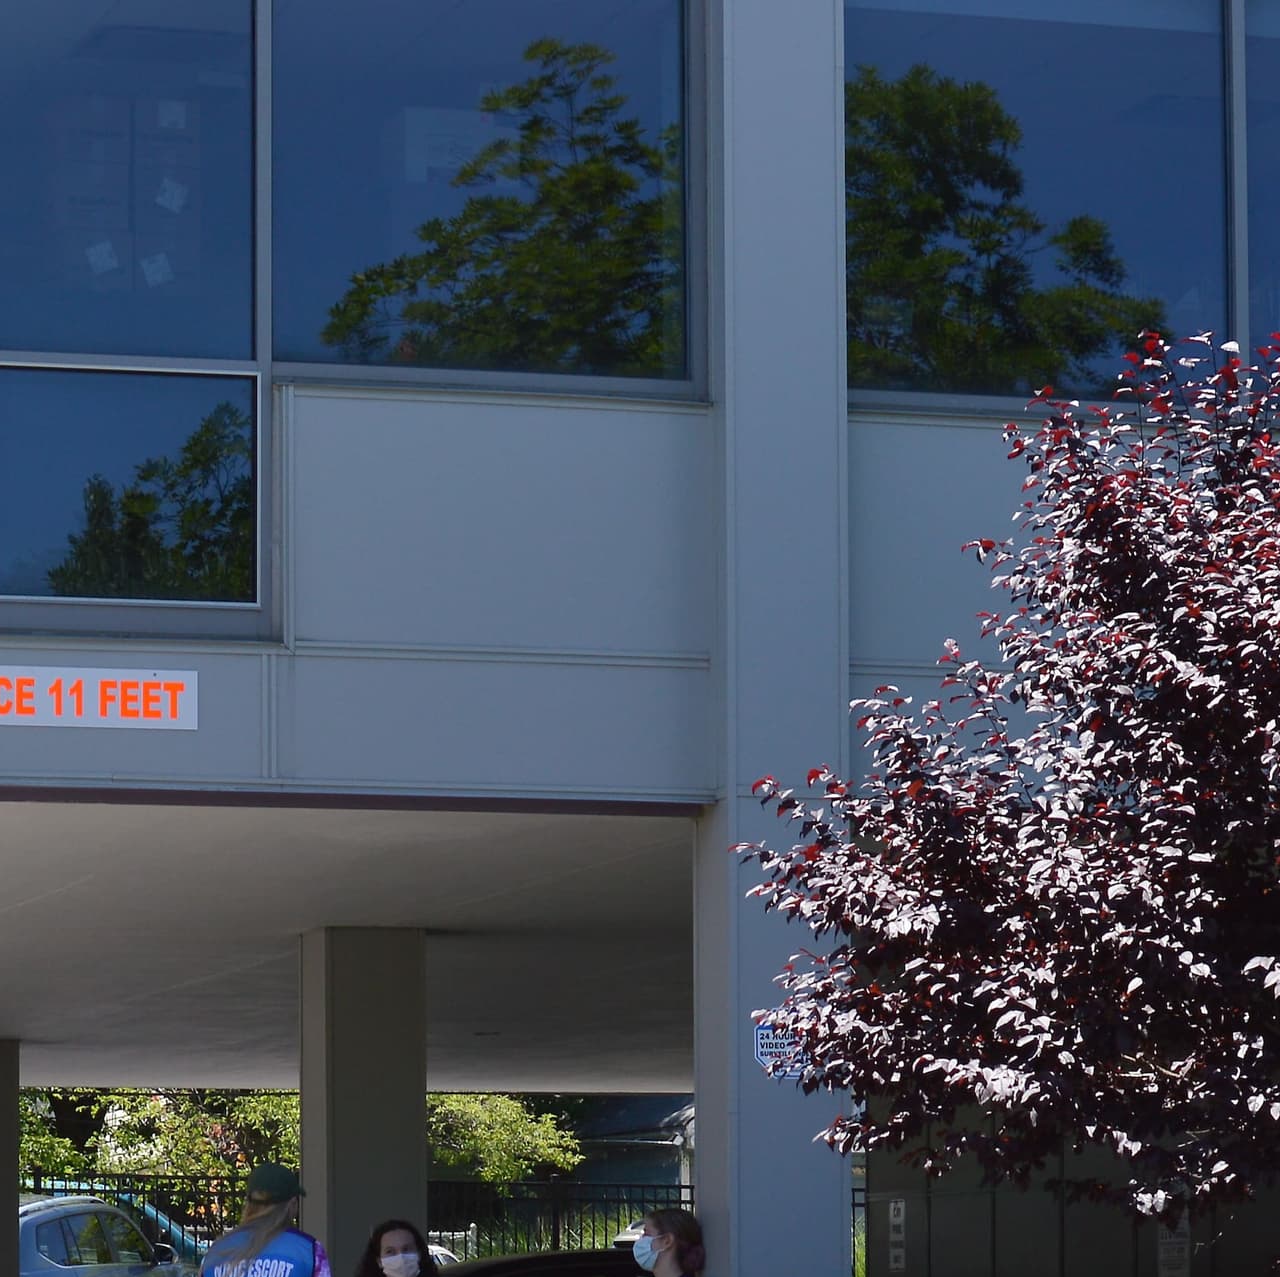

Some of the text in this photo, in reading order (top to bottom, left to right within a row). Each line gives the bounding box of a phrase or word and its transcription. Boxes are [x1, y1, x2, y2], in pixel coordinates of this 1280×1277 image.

[47, 679, 84, 717] 11
[99, 680, 185, 719] FEET
[759, 1041, 786, 1050] VIDEO
